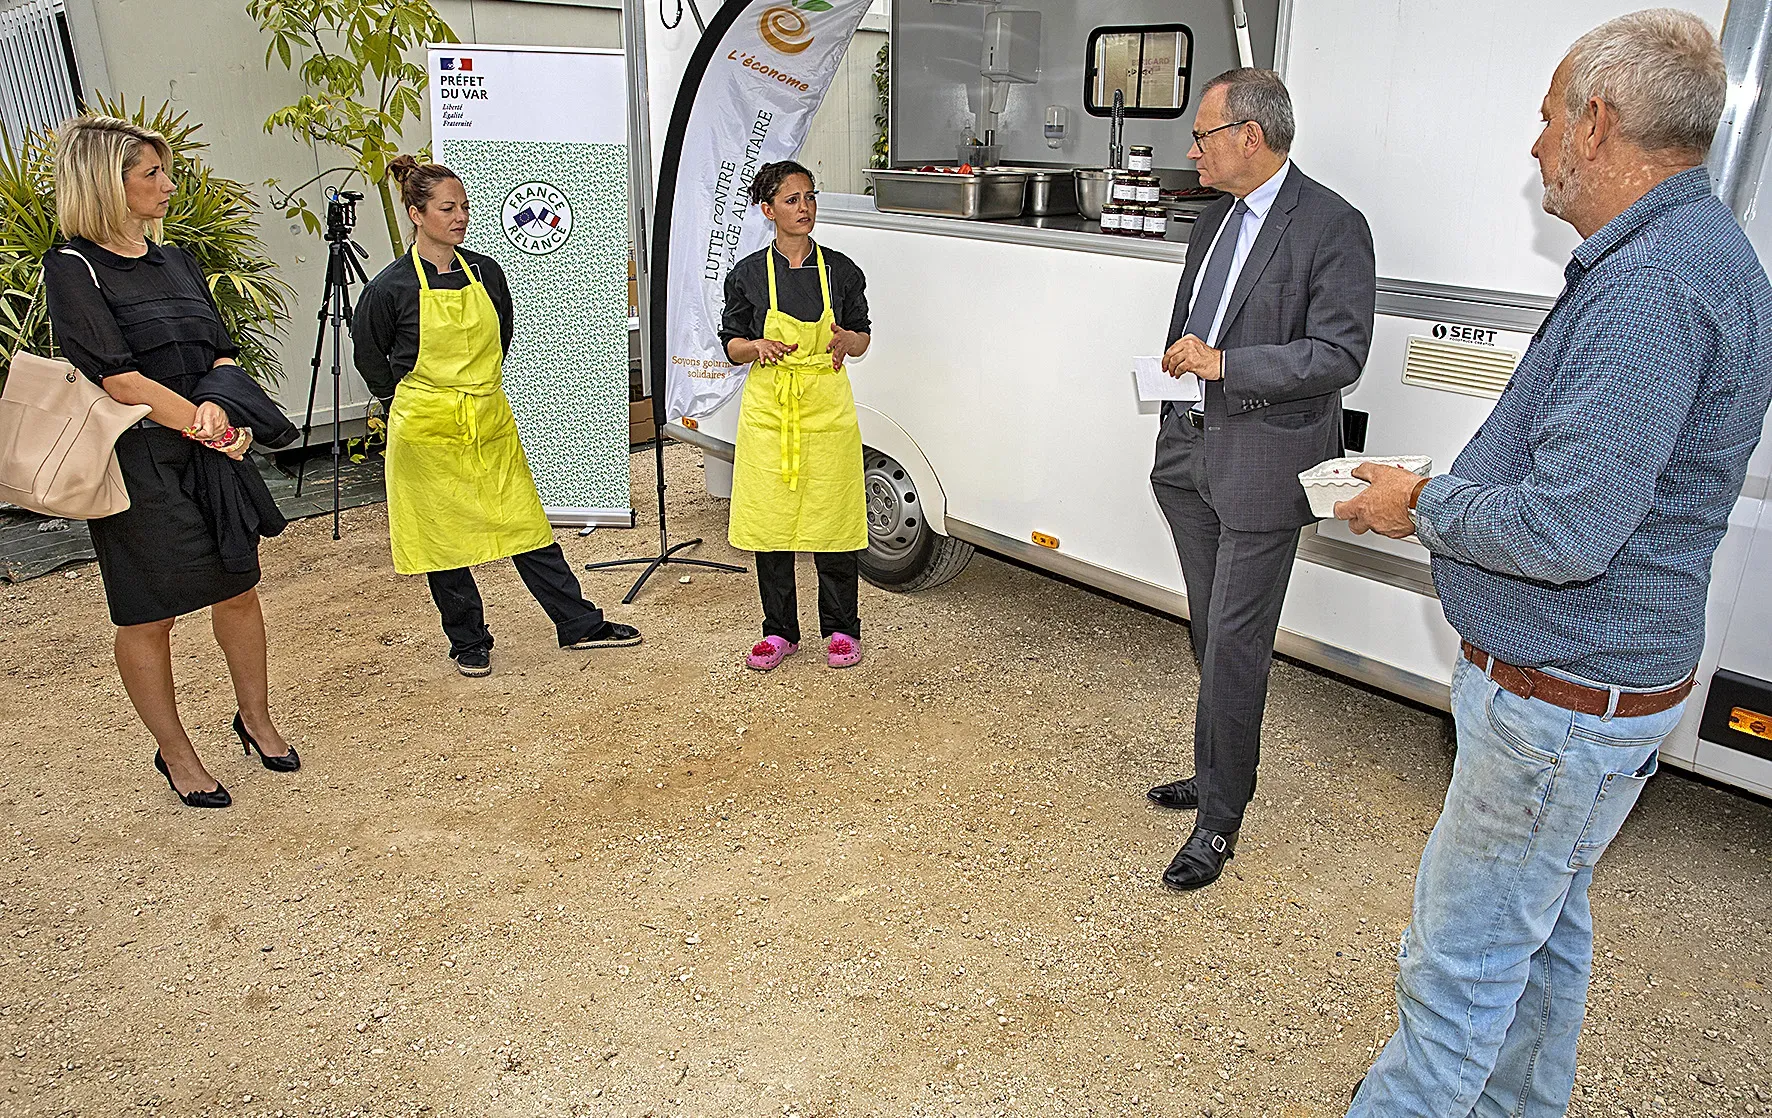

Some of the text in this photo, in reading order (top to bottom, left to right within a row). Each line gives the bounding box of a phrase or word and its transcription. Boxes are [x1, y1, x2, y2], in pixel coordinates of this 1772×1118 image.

[728, 50, 809, 91] L'économe
[440, 73, 485, 87] PRÉFET
[441, 88, 489, 100] DU VAR
[442, 103, 463, 111] Liberté
[442, 111, 464, 120] Égalité
[732, 109, 773, 221] ALIMENTAIRE
[508, 186, 566, 211] FRANCE
[713, 160, 736, 225] CONTRE
[507, 225, 567, 251] RELANCE
[704, 229, 725, 281] LUTTE
[1449, 325, 1498, 343] SERT
[671, 355, 734, 369] Soyons gourm
[687, 369, 726, 379] solidaires
